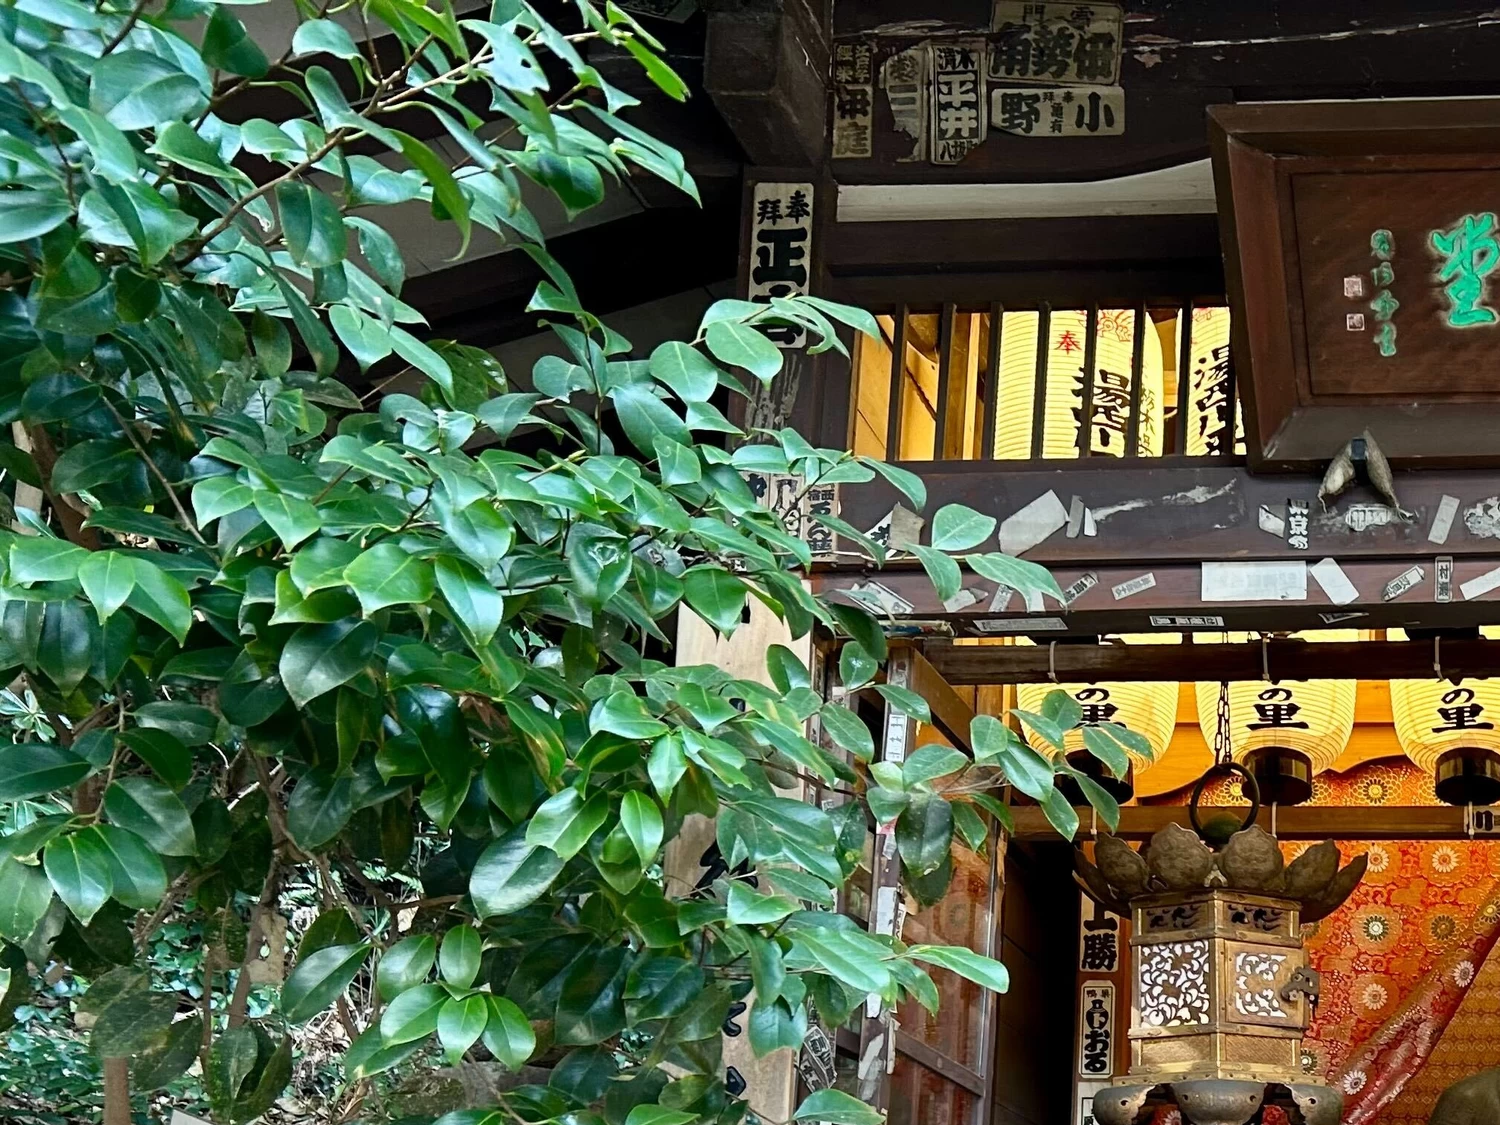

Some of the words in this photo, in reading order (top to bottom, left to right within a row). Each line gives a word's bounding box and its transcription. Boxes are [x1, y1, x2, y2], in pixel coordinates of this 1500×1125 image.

[937, 73, 978, 139] 平井
[1246, 688, 1310, 730] の里
[1432, 687, 1495, 734] の里
